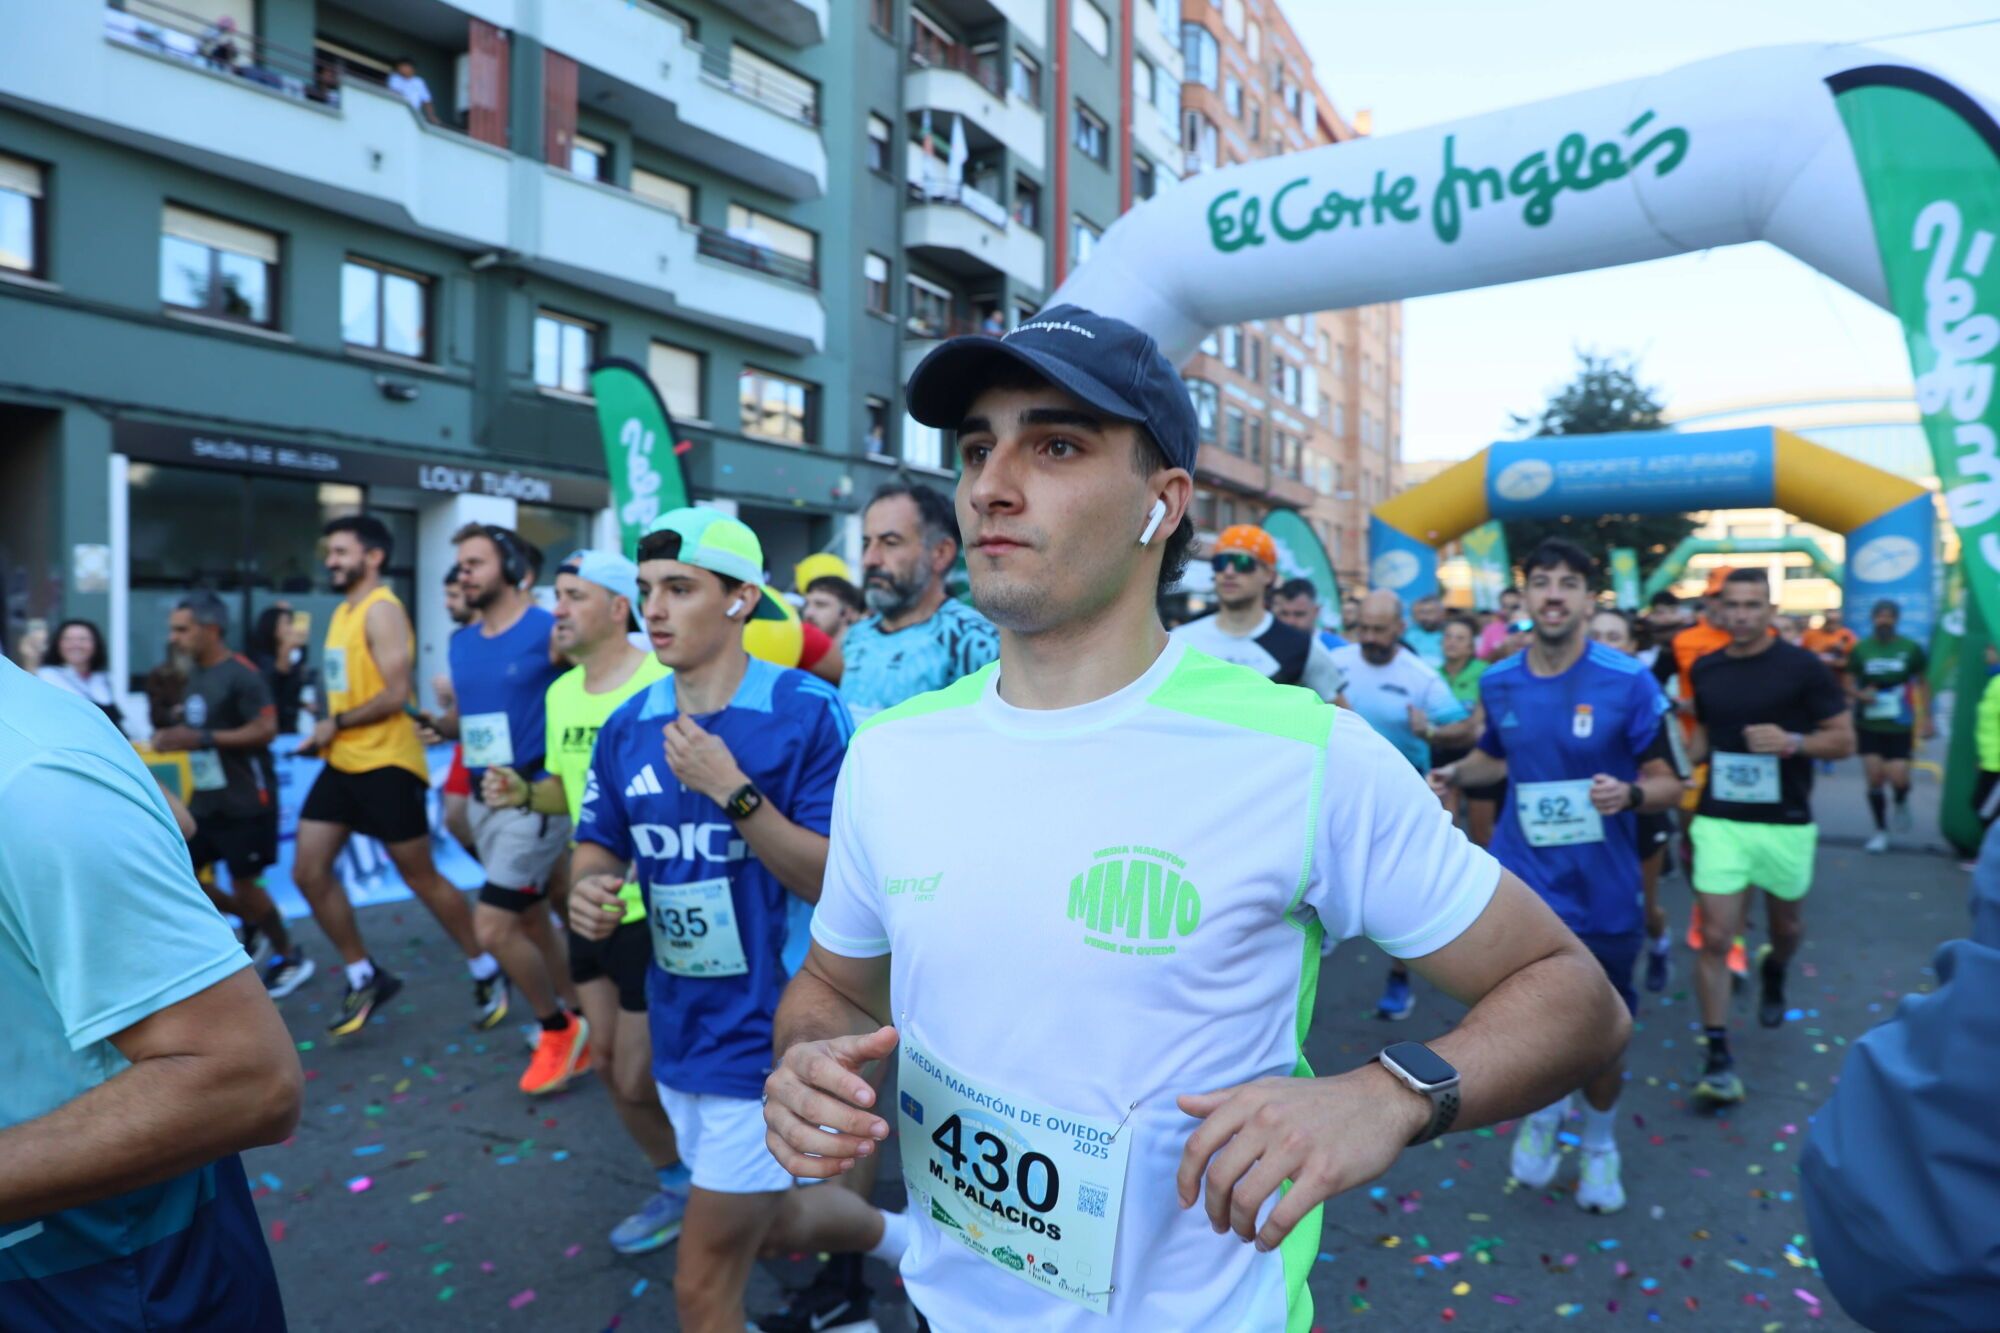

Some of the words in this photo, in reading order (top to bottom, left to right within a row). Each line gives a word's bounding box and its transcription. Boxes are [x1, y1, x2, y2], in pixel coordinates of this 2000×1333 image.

[1207, 189, 1267, 253] El
[1270, 170, 1421, 242] Corte
[1433, 110, 1689, 244] Inglés
[191, 436, 248, 460] SALÓN
[251, 445, 273, 465] DE
[418, 463, 474, 493] LOLY
[1538, 796, 1571, 819] 62
[1093, 845, 1130, 860] MEDIA
[1066, 859, 1202, 940] MMVO
[1119, 944, 1135, 955] DE
[908, 1046, 943, 1083] MEDIA
[945, 1074, 1016, 1119] MARATÓN
[1020, 1109, 1042, 1127] DE
[1046, 1117, 1112, 1147] OVIEDO
[931, 1113, 1060, 1213] 430
[1073, 1139, 1110, 1161] 2025
[929, 1158, 949, 1184] M.
[954, 1176, 1062, 1241] PALACIOS
